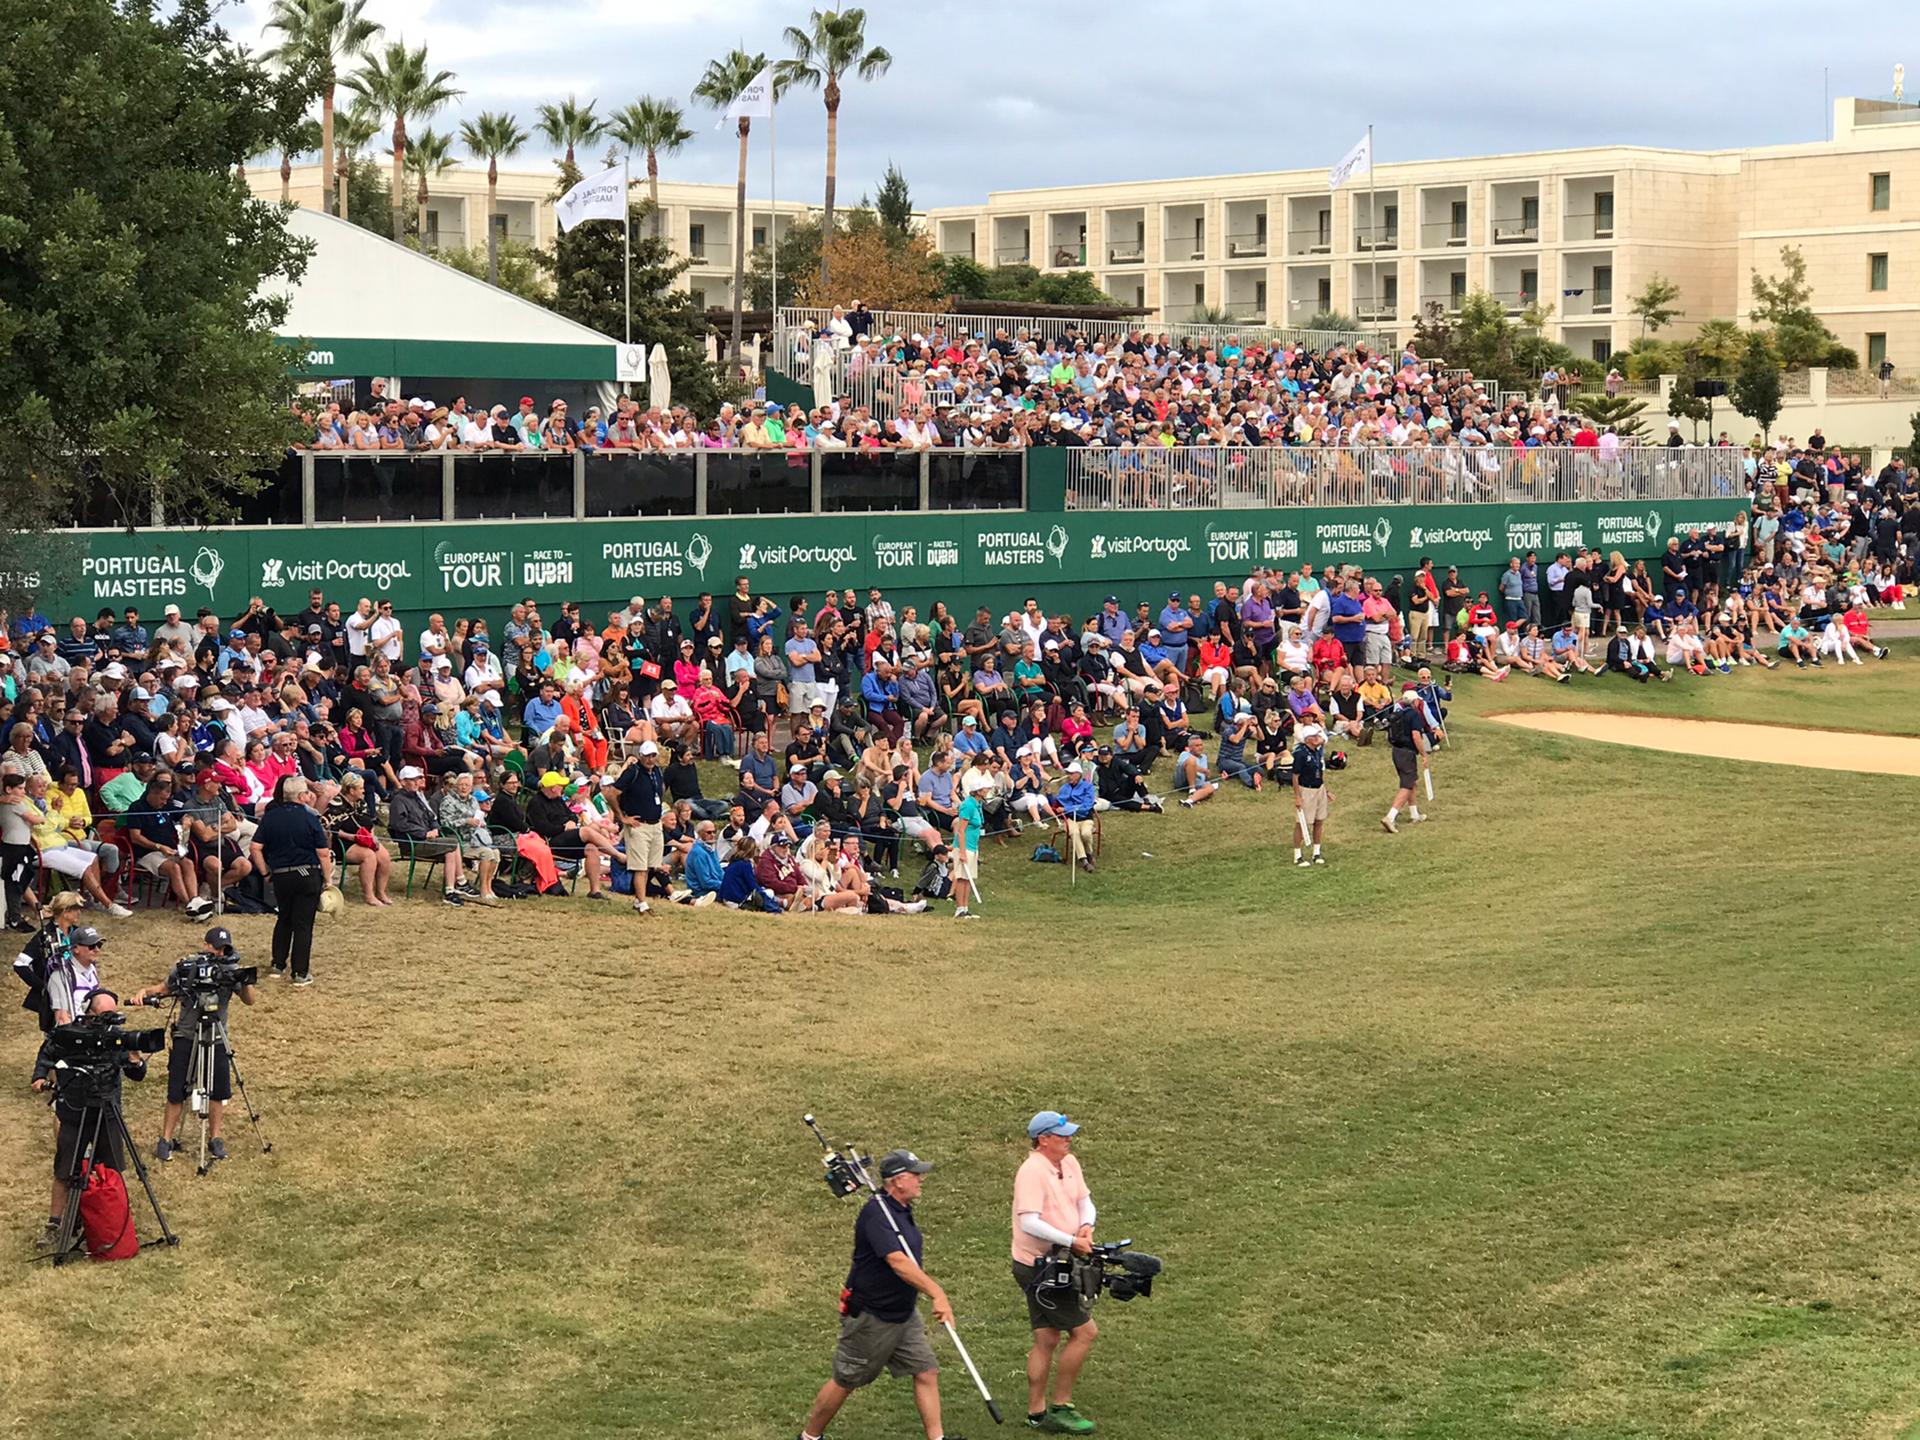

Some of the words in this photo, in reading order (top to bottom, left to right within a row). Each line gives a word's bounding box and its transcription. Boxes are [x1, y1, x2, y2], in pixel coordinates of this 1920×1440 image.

[1316, 523, 1372, 540] PORTUGAL
[1597, 516, 1645, 530] PORTUGAL
[977, 532, 1045, 549] PORTUGAL
[1321, 539, 1372, 555] MASTERS
[1423, 527, 1445, 544] visit
[1444, 528, 1494, 551] Portugal
[1506, 531, 1543, 553] TOUR
[1601, 530, 1645, 545] MASTERS
[533, 550, 552, 560] RACE
[553, 549, 564, 559] TO
[602, 542, 683, 560] PORTUGAL
[758, 543, 788, 565] visit
[788, 544, 858, 573] Portugal
[926, 548, 959, 567] DUBAI
[984, 547, 1045, 567] MASTERS
[1106, 536, 1133, 554] visit
[1133, 535, 1192, 562] Portugal
[1207, 541, 1250, 564] TOUR
[1263, 539, 1298, 561] DUBAI
[82, 555, 186, 577] PORTUGAL
[611, 558, 683, 579] MASTERS
[874, 550, 915, 570] TOUR
[286, 560, 323, 582] visit
[325, 559, 412, 591] Portugal
[438, 563, 503, 593] TOUR
[523, 561, 574, 588] DUBAI
[93, 577, 187, 599] MASTERS
